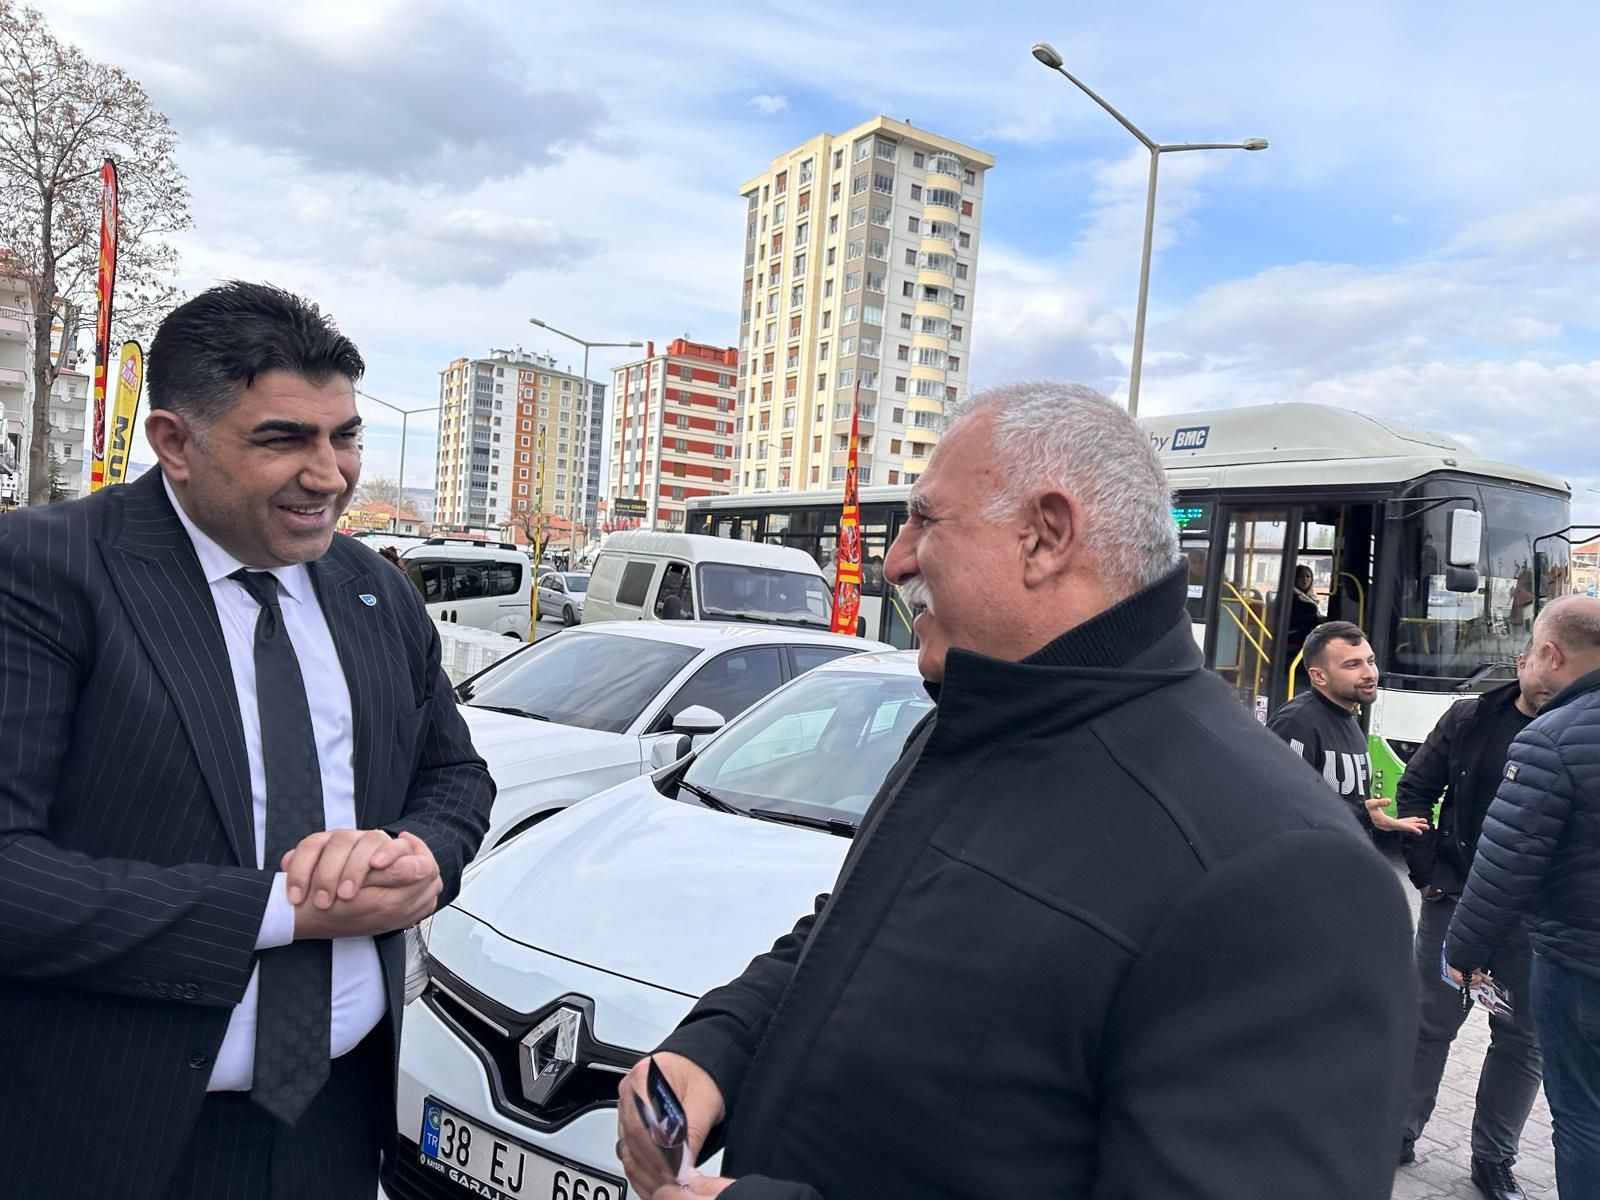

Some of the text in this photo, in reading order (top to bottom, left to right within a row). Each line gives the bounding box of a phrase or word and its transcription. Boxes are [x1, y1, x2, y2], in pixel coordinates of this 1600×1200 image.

[109, 415, 129, 479] MU
[1174, 428, 1207, 448] BMC
[427, 1132, 439, 1148] TR
[441, 1118, 471, 1167] 38
[490, 1140, 525, 1193] EJ
[447, 1169, 500, 1200] GARAJ
